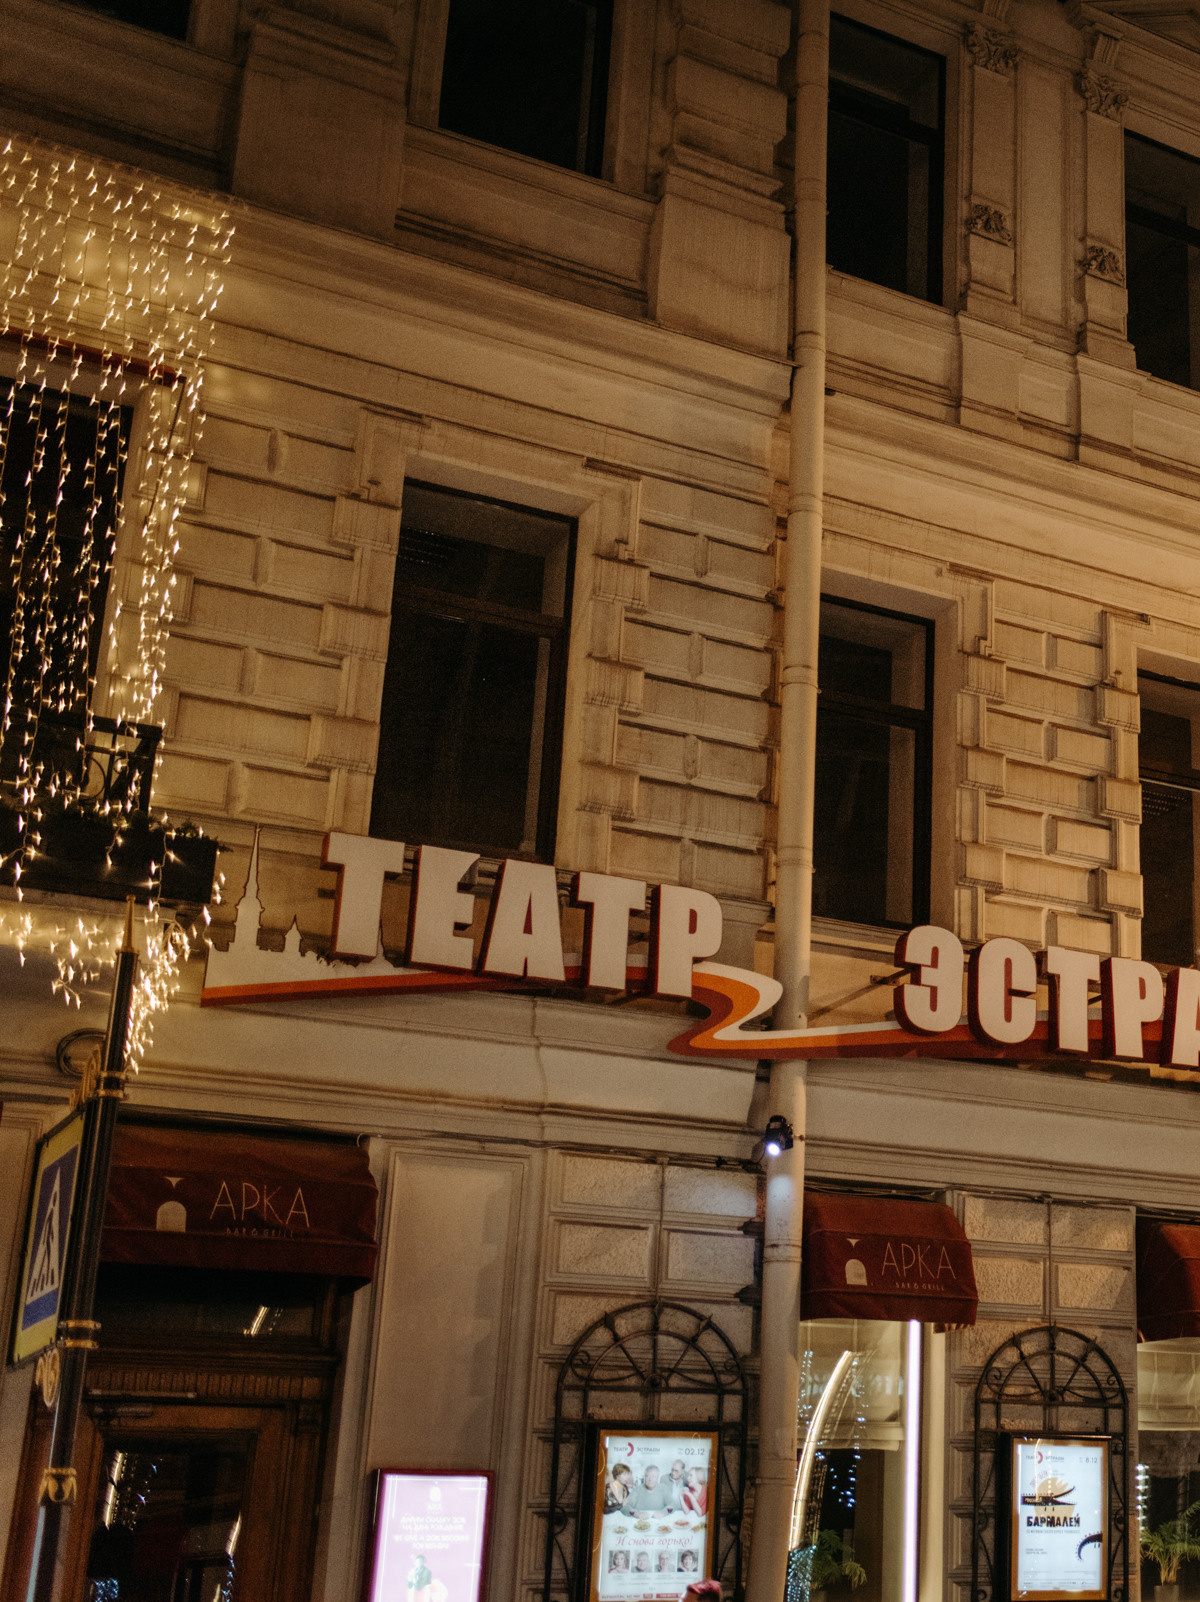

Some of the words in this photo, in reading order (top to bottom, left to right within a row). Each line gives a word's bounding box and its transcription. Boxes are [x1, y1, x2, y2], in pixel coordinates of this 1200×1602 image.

[321, 831, 723, 998] ТЕАТР
[209, 1180, 310, 1228] АРКА
[881, 1241, 957, 1280] АРКА
[684, 1448, 705, 1456] 02.12
[1026, 1513, 1081, 1527] БАРМАЛЕЙ
[627, 1537, 655, 1546] снова
